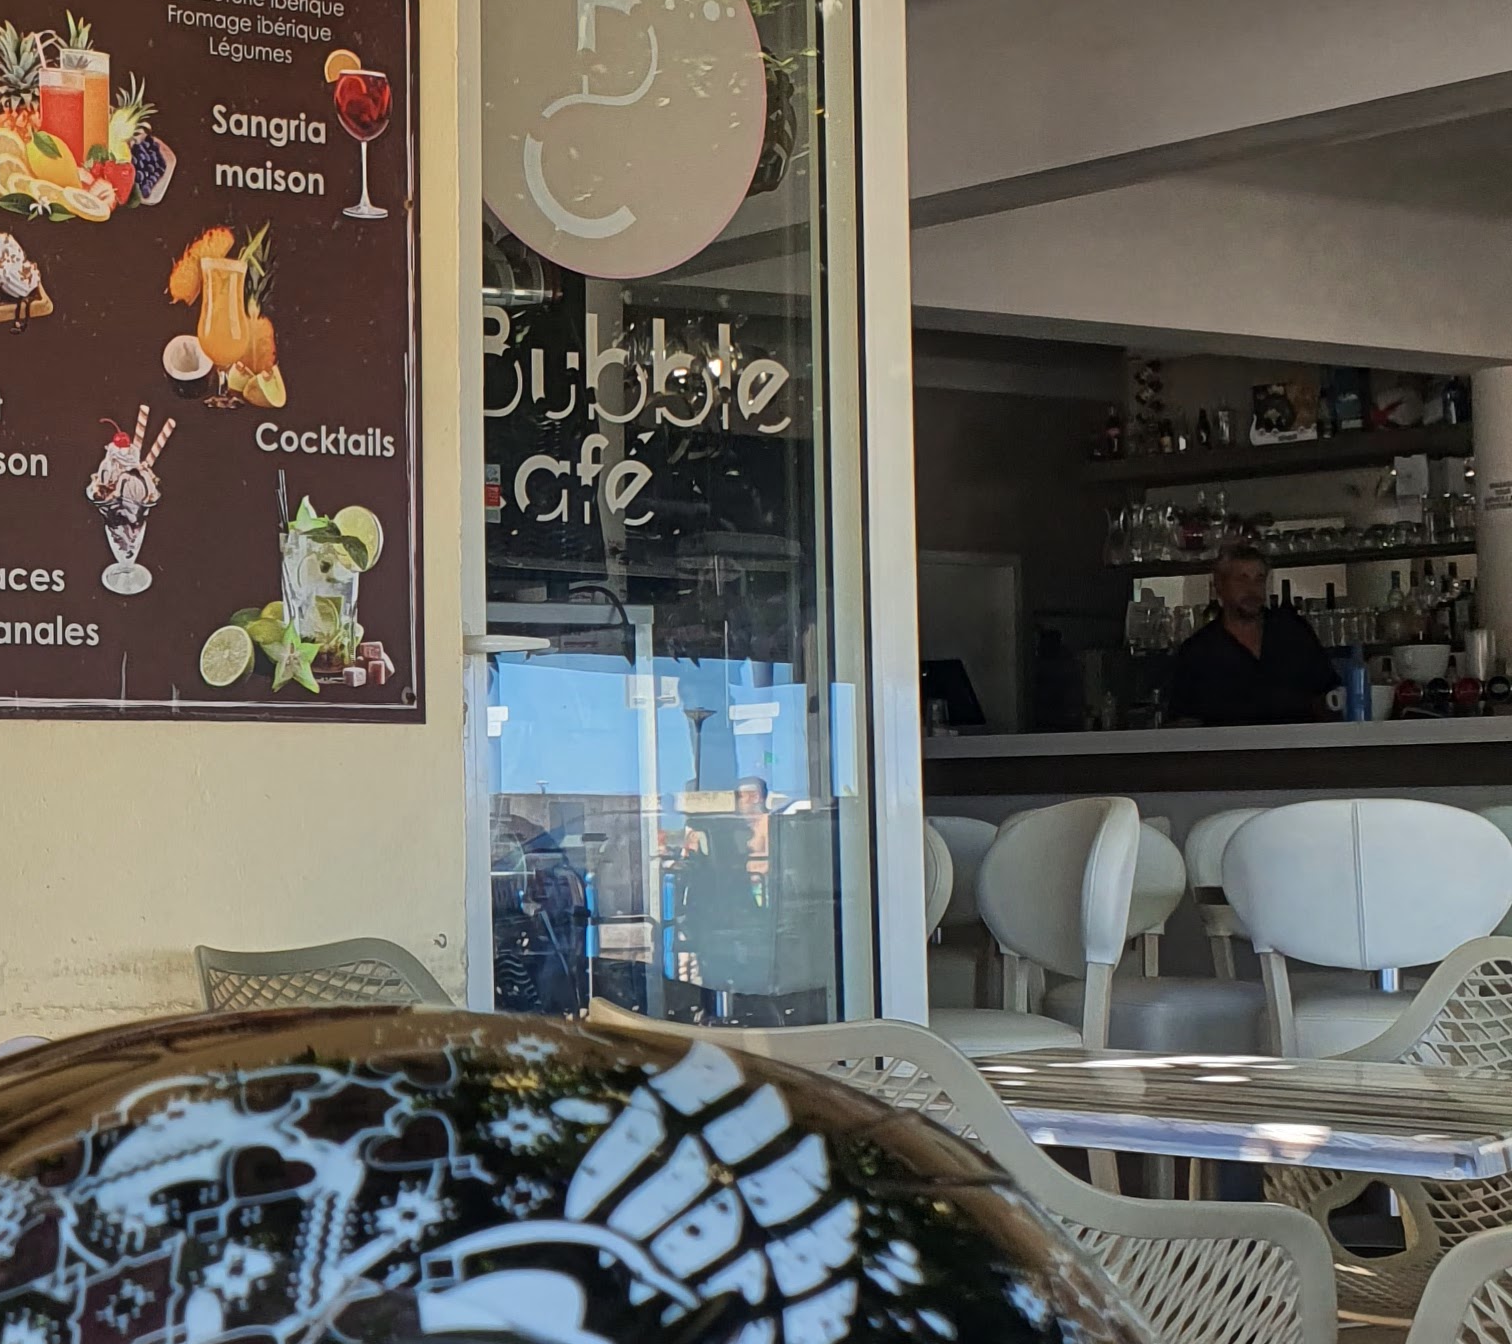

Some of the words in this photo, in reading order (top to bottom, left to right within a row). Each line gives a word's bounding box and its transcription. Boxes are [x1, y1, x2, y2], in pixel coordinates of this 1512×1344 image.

[167, 4, 252, 35] Fromage
[256, 15, 332, 43] ibérique
[209, 37, 293, 64] Légumes
[211, 104, 327, 147] Sangria
[215, 160, 325, 195] maison
[255, 422, 396, 458] Cocktails
[501, 432, 655, 527] afé
